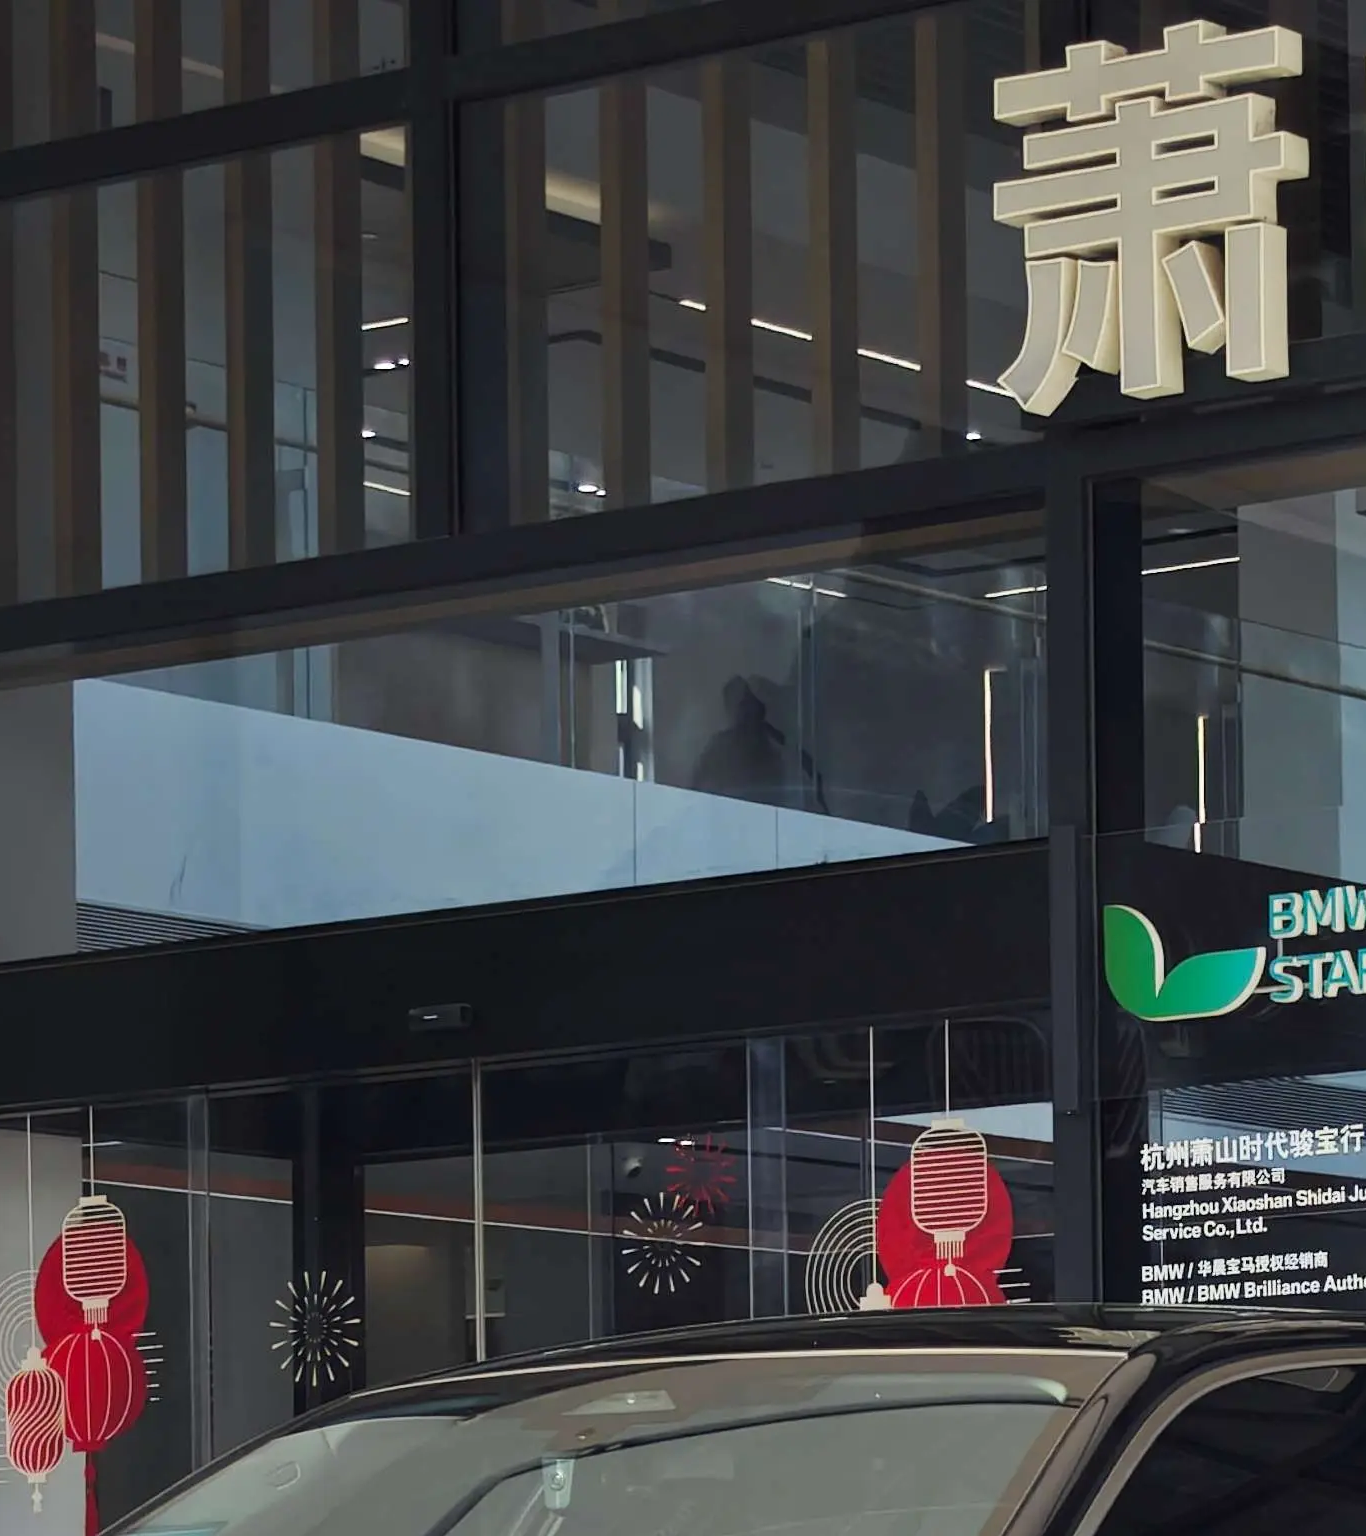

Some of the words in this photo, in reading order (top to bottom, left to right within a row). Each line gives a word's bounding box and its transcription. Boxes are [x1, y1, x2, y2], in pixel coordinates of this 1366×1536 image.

[1140, 1123, 1365, 1172] 杭州萧山时代骏宝行
[1141, 1167, 1286, 1196] 汽车销售服务有限公司
[1141, 1199, 1220, 1221] Hangzhou
[1221, 1193, 1293, 1213] Xiaoshan
[1296, 1186, 1346, 1207] Shidai
[1142, 1223, 1201, 1242] Service
[1141, 1262, 1185, 1282] BMW
[1197, 1250, 1329, 1278] 华晨宝马授权经销商
[1140, 1286, 1185, 1305] BMW
[1197, 1282, 1242, 1302] BMW
[1243, 1279, 1320, 1298] Brilliance
